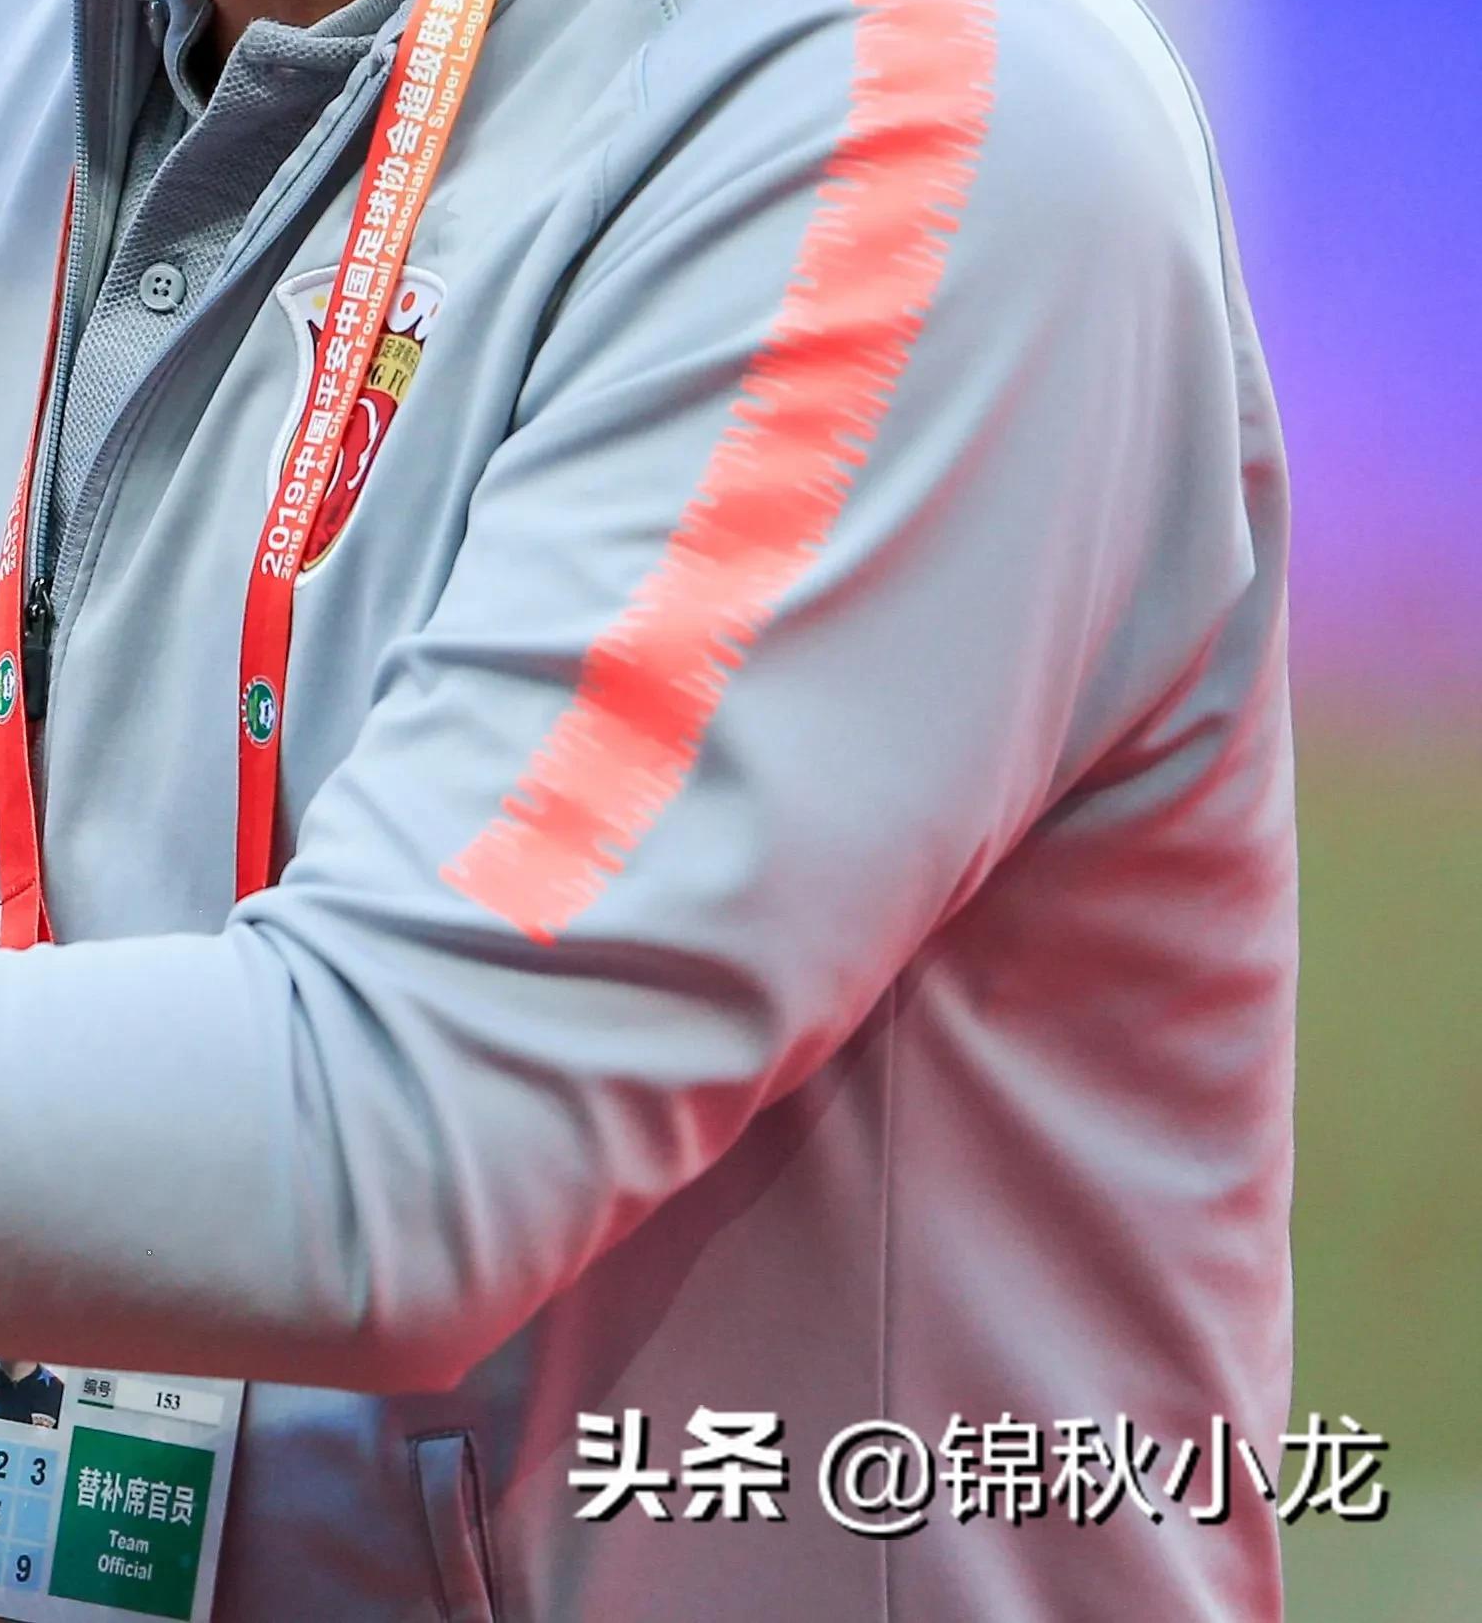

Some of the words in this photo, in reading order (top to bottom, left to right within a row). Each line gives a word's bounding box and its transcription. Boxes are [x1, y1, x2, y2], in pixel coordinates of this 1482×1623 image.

[297, 480, 323, 524] Ping
[316, 444, 333, 473] An
[327, 353, 364, 439] Chinese
[355, 262, 394, 349] Football
[386, 135, 439, 258] Association
[428, 64, 462, 129] Super
[83, 1377, 112, 1398] 编号
[155, 1391, 181, 1410] 153
[31, 1458, 47, 1486] 3
[77, 1465, 196, 1527] 替补席官员
[109, 1529, 150, 1554] Team
[16, 1554, 32, 1582] 9
[98, 1552, 154, 1581] Official
